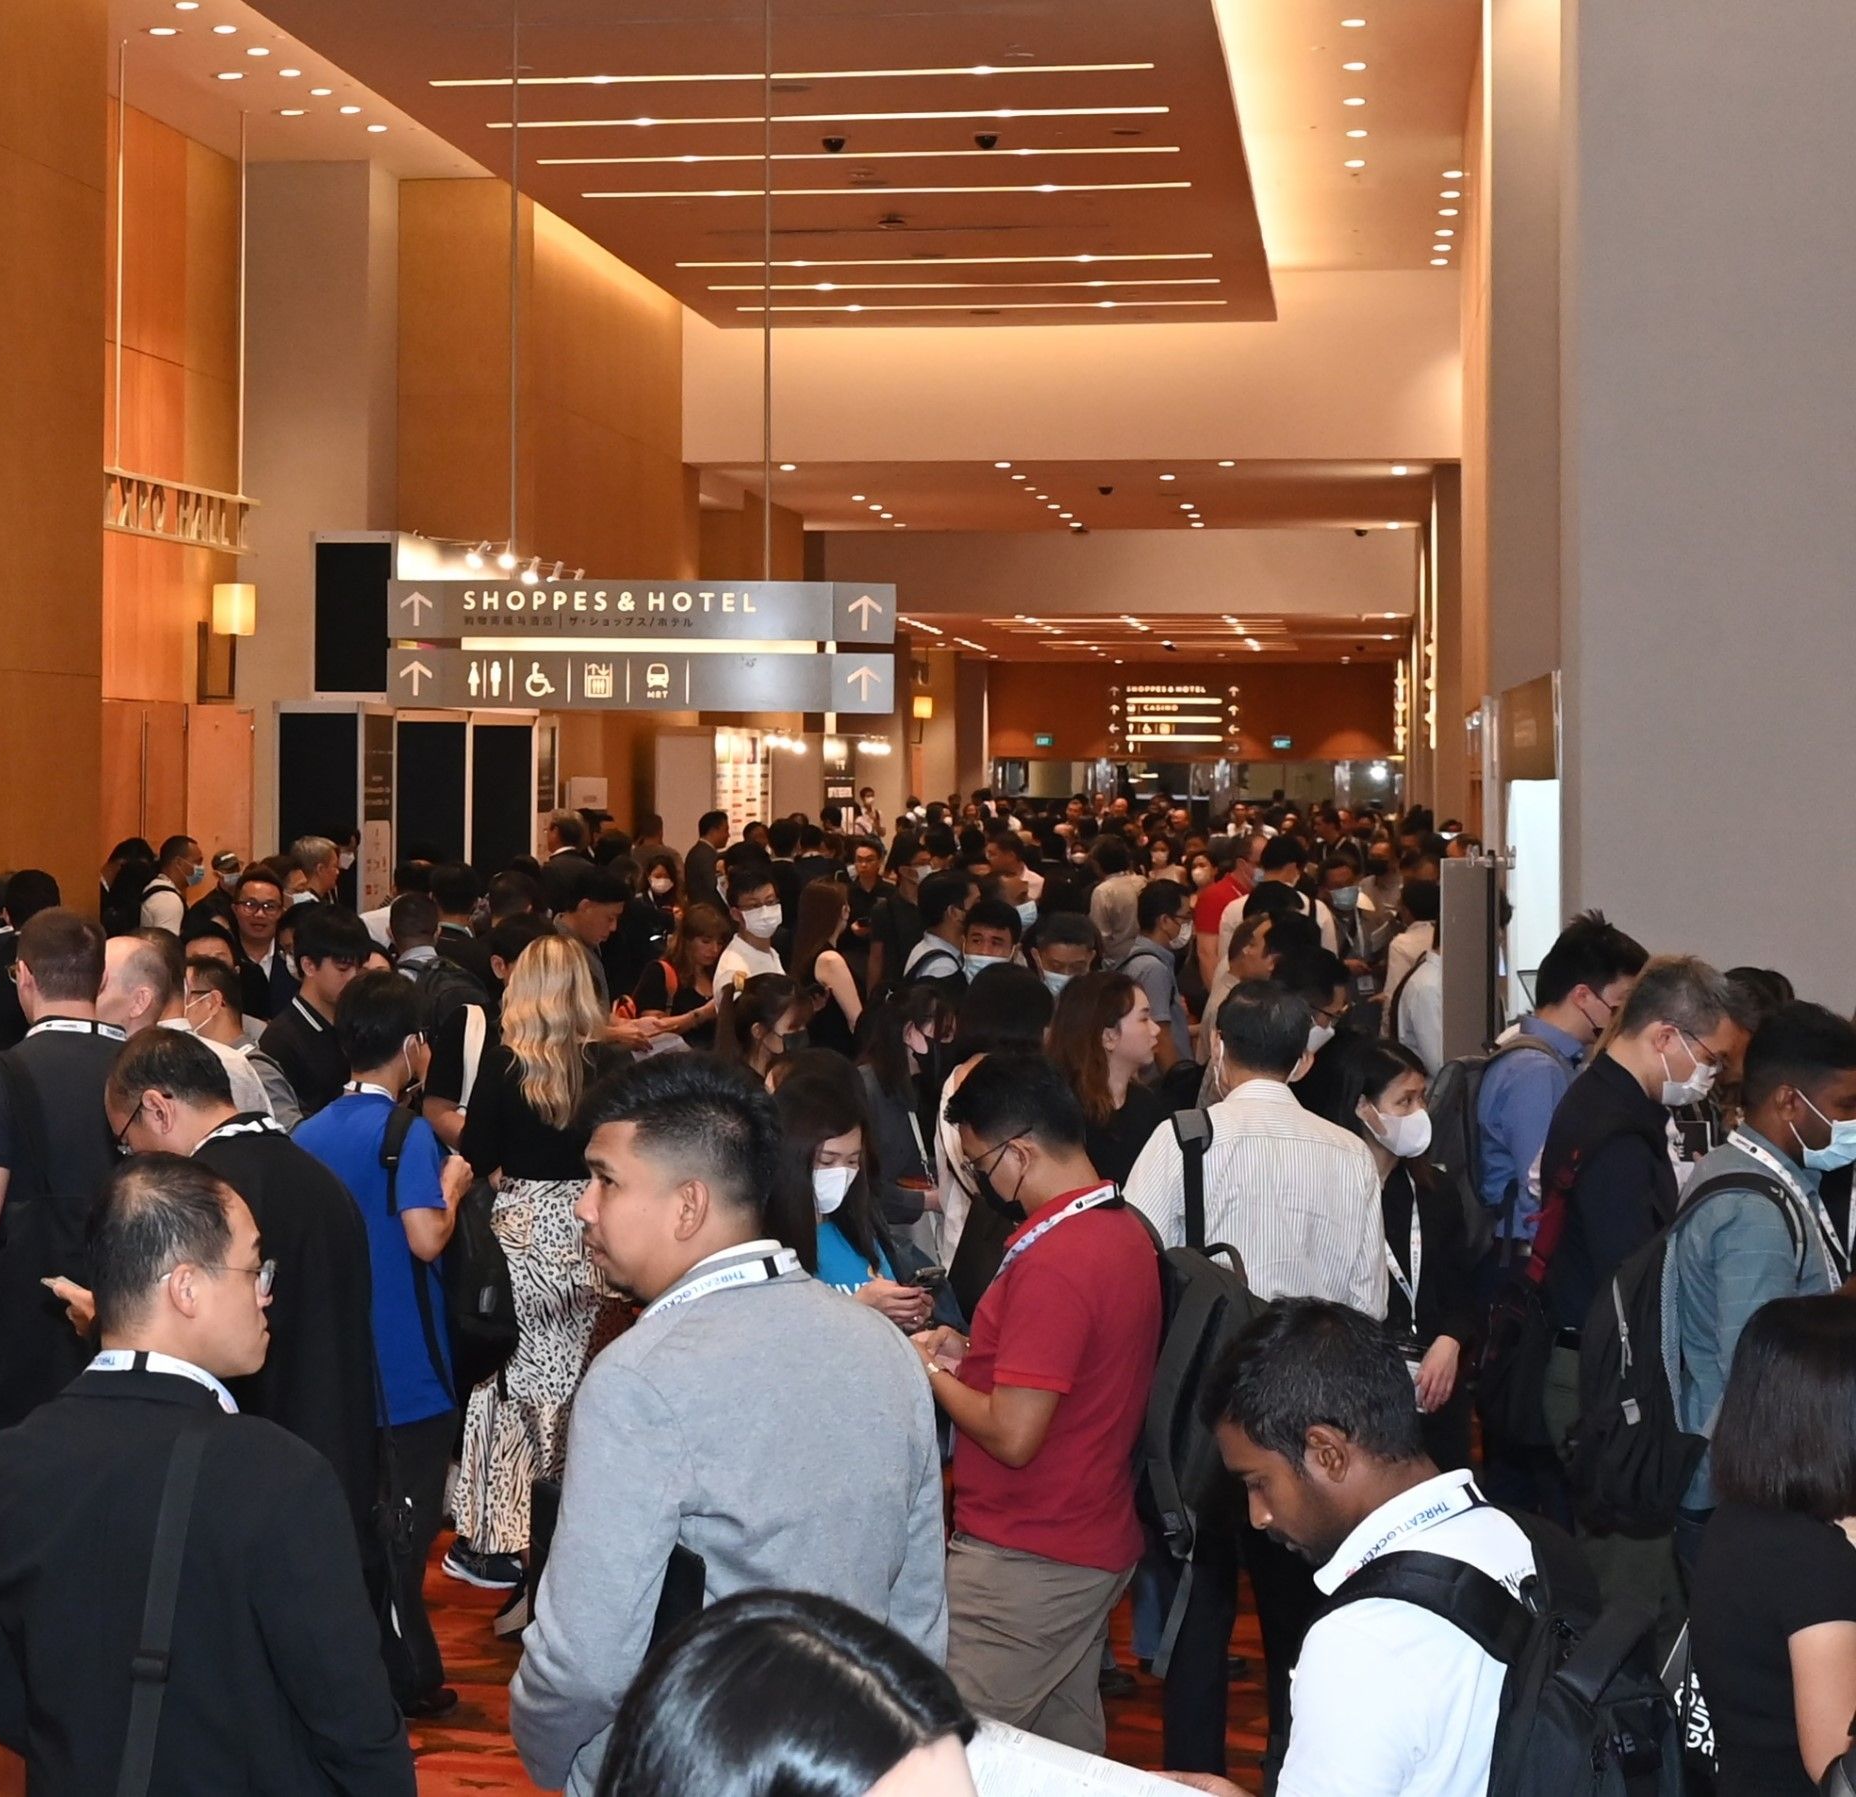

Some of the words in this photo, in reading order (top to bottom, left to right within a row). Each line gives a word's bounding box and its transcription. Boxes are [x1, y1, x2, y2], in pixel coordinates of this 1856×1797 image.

[176, 488, 230, 546] HALL
[463, 591, 607, 612] SHOPPES
[617, 592, 636, 612] &
[647, 592, 756, 613] HOTEL
[646, 690, 669, 699] MRT
